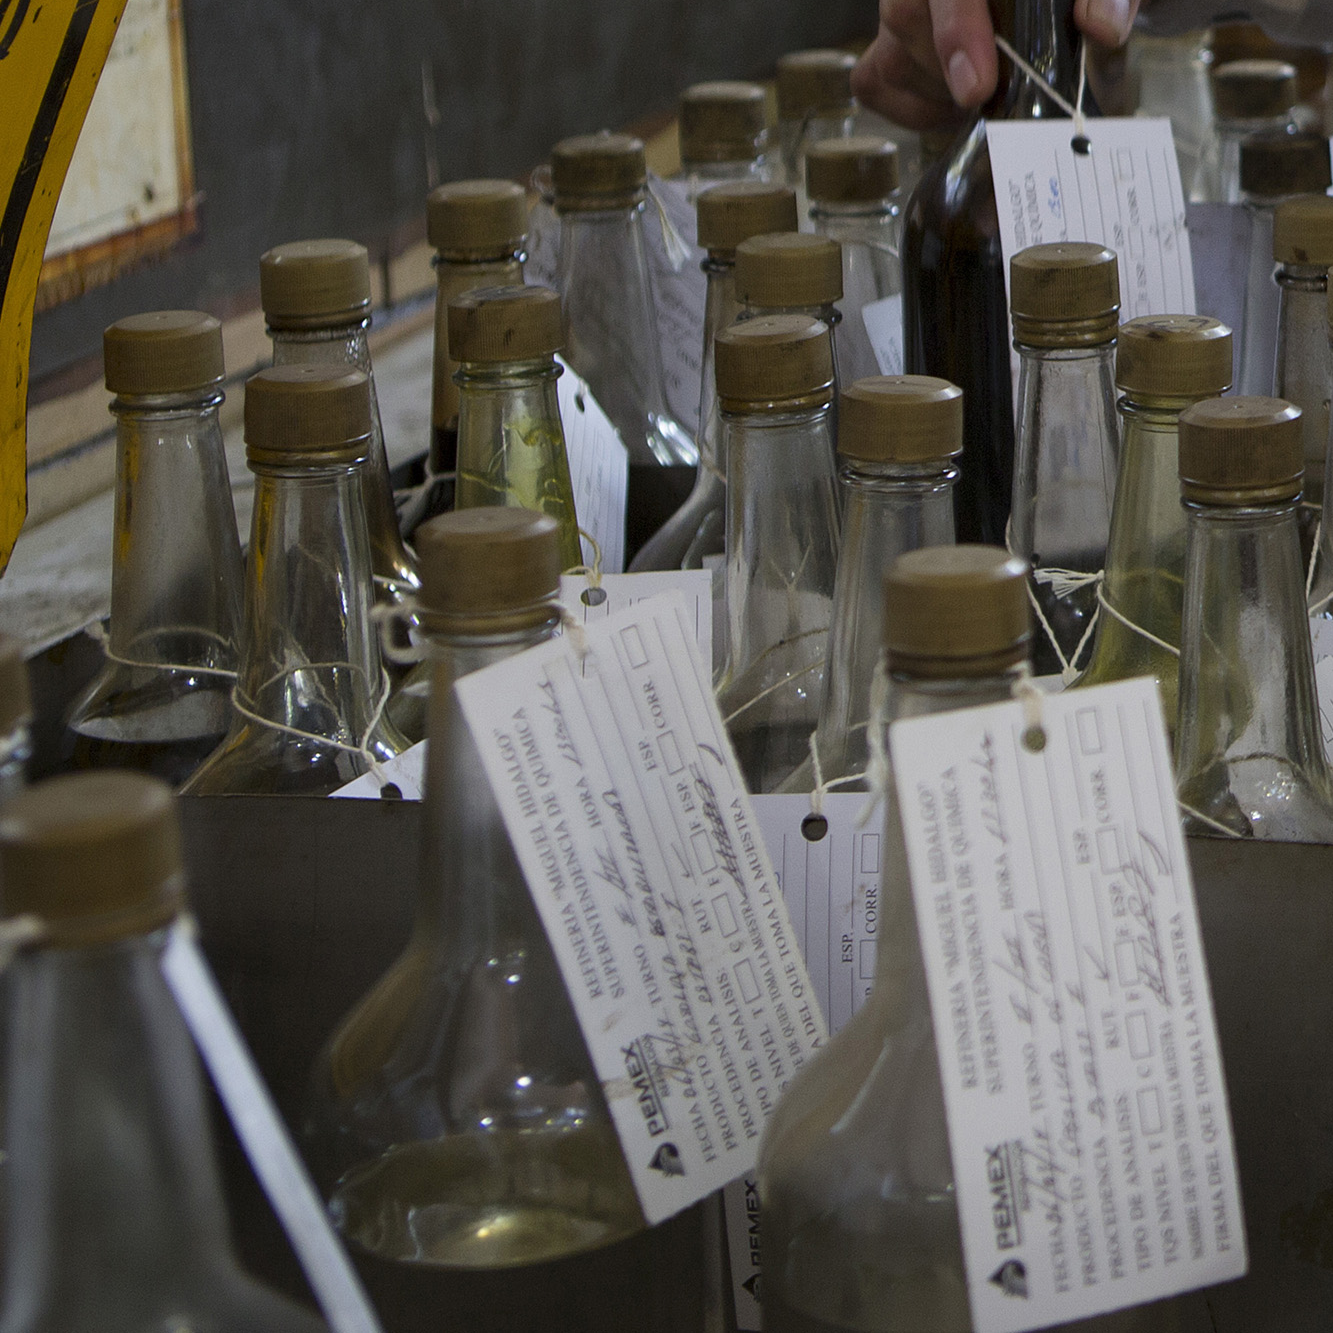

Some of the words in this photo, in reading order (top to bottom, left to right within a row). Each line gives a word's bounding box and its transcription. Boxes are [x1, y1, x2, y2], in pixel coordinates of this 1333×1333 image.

[640, 674, 667, 730] CORR.
[510, 707, 554, 789] QUIMICA
[540, 790, 562, 818] DE
[573, 775, 602, 829] HORA
[728, 796, 765, 880] MUESTRA
[551, 819, 626, 999] SUPERINTENDENCIA
[756, 881, 773, 906] LA
[864, 883, 877, 933] CORR.
[558, 902, 604, 1000] REFINERIA
[764, 907, 791, 961] TOMA
[841, 932, 853, 962] ESP.
[631, 942, 663, 1008] TURNO
[782, 960, 805, 999] QUE
[796, 999, 817, 1035] DEL
[705, 1013, 757, 1140] PROCEDENCIA
[744, 1055, 762, 1082] DE
[756, 1021, 785, 1079] NIVEL
[619, 1041, 664, 1138] PEMEX
[695, 1052, 737, 1151] PRODUCTO
[685, 1101, 717, 1163] FECHA
[982, 1143, 1014, 1251] PEMEX
